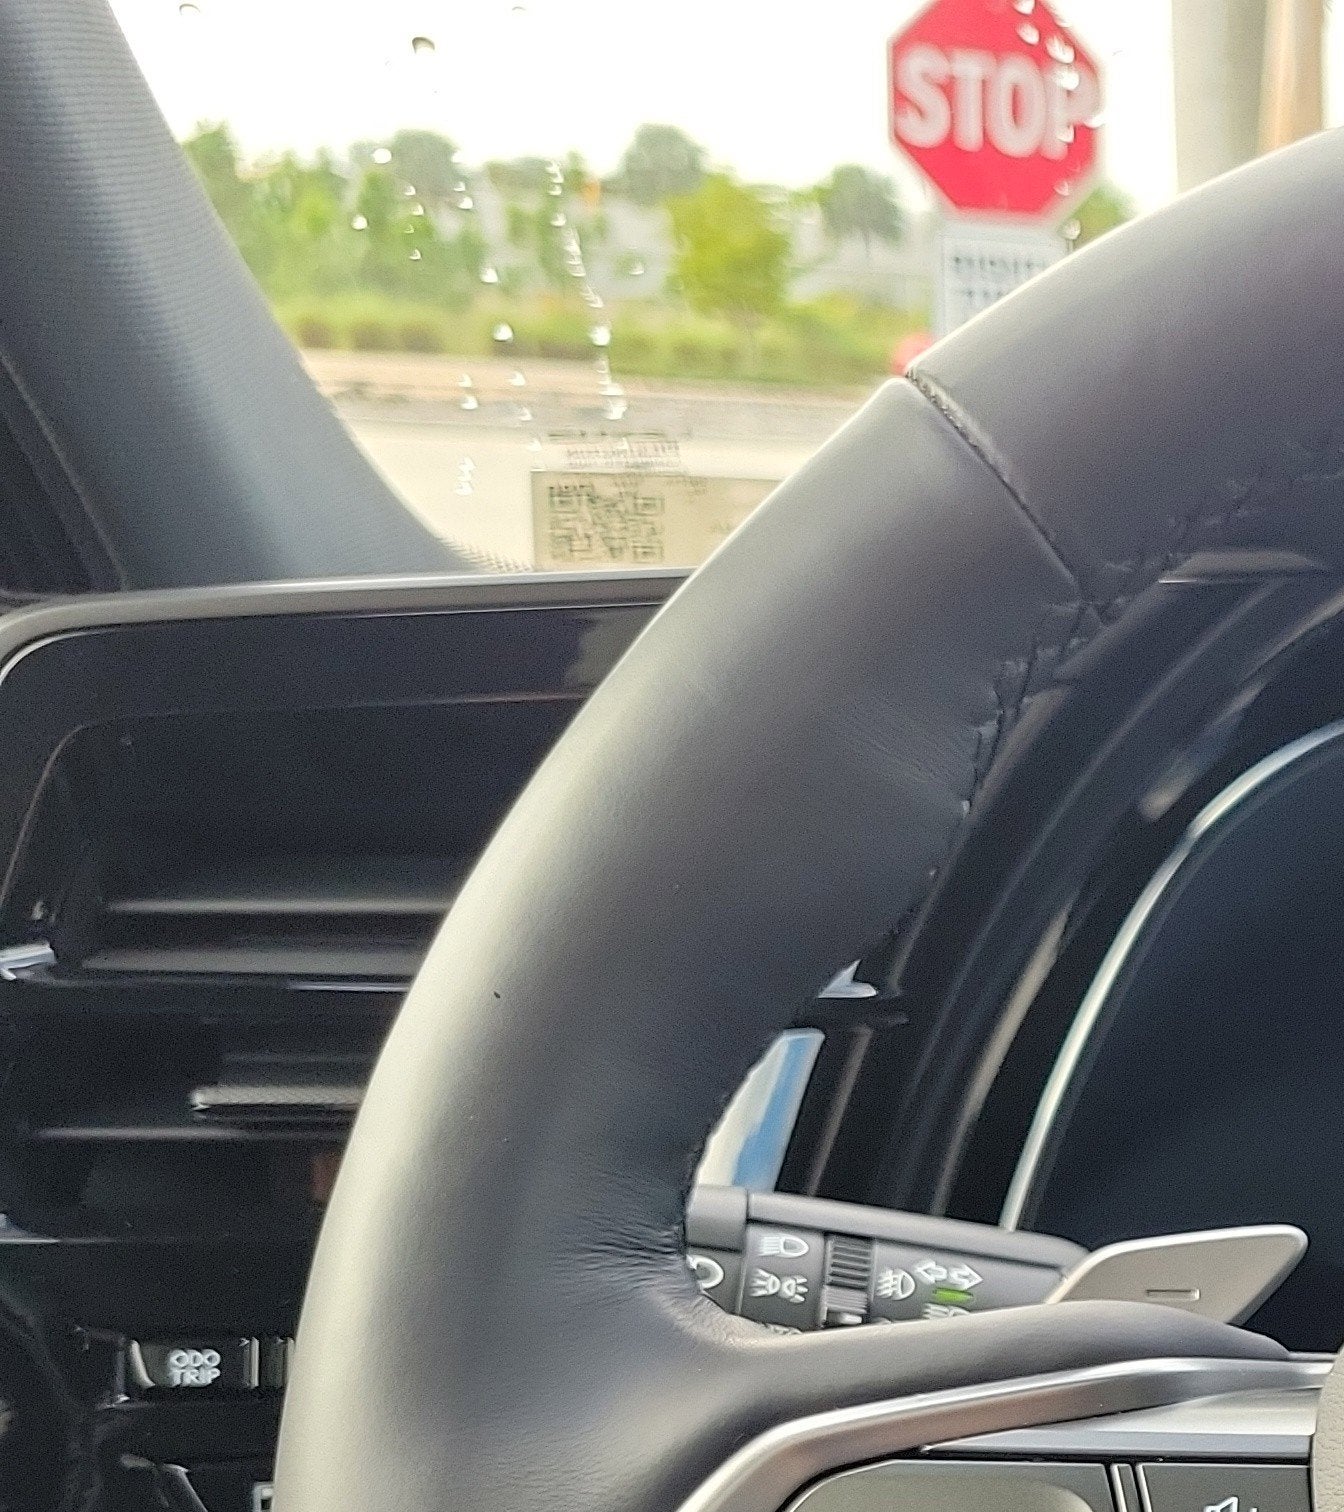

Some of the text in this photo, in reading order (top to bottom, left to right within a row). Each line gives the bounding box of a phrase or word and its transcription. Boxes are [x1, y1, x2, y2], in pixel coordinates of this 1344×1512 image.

[894, 42, 1102, 161] STOP
[168, 1349, 221, 1367] ODO
[168, 1368, 221, 1387] TRIP
